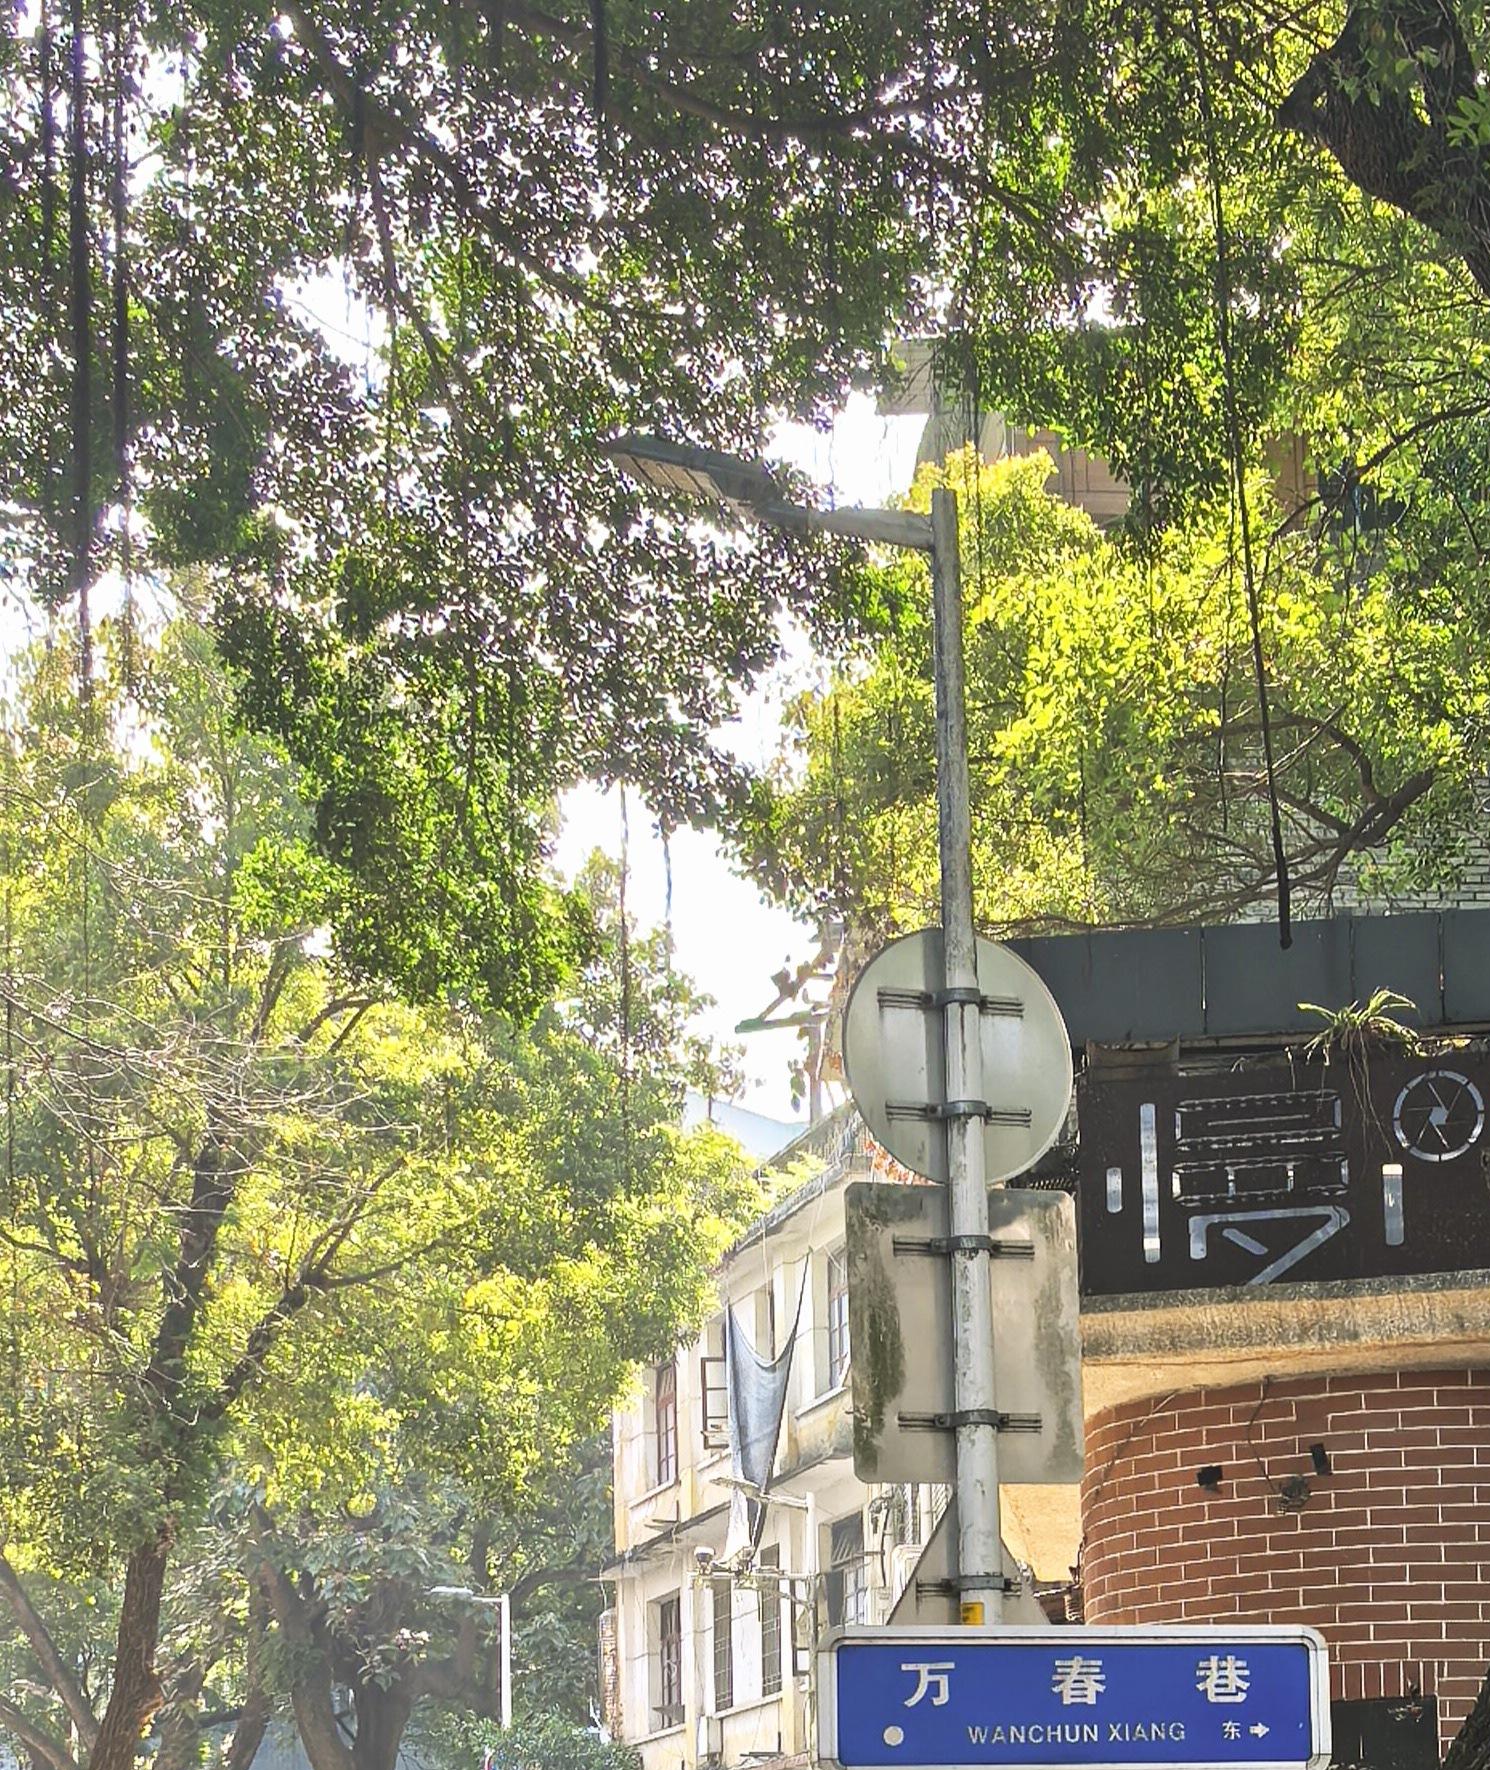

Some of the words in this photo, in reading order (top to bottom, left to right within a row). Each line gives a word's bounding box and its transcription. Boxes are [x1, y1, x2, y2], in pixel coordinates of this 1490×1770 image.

[900, 1654, 1252, 1707] 万春巷
[967, 1723, 1099, 1745] WANCHUN
[1108, 1722, 1186, 1742] XIANG
[1222, 1720, 1242, 1740] 东
